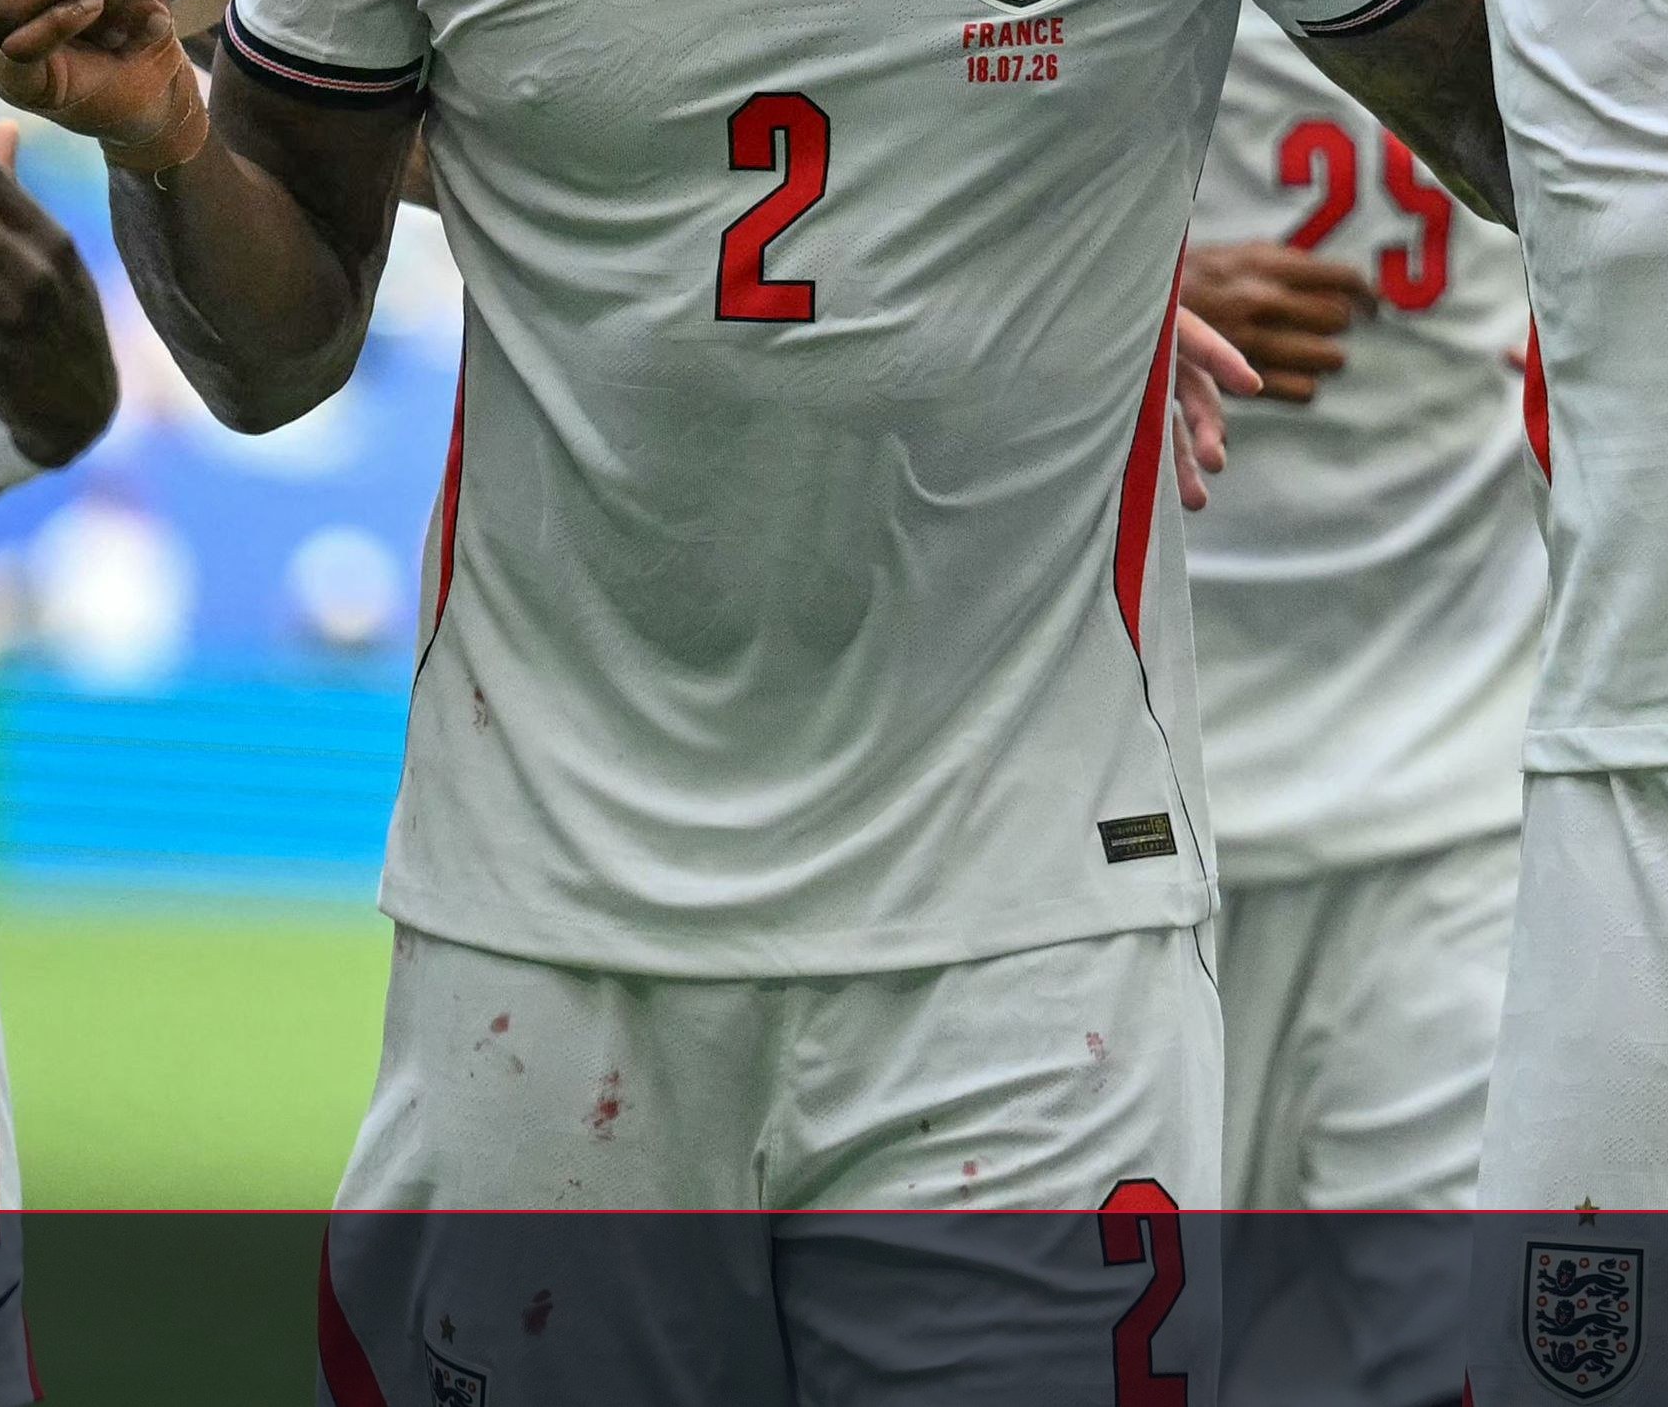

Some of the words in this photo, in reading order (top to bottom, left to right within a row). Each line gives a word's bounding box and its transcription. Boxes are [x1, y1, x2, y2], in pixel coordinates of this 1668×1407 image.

[962, 17, 1065, 50] FRANCE
[966, 53, 1058, 82] 18.07.26
[714, 91, 831, 323] 2
[1097, 1177, 1189, 1407] 2
